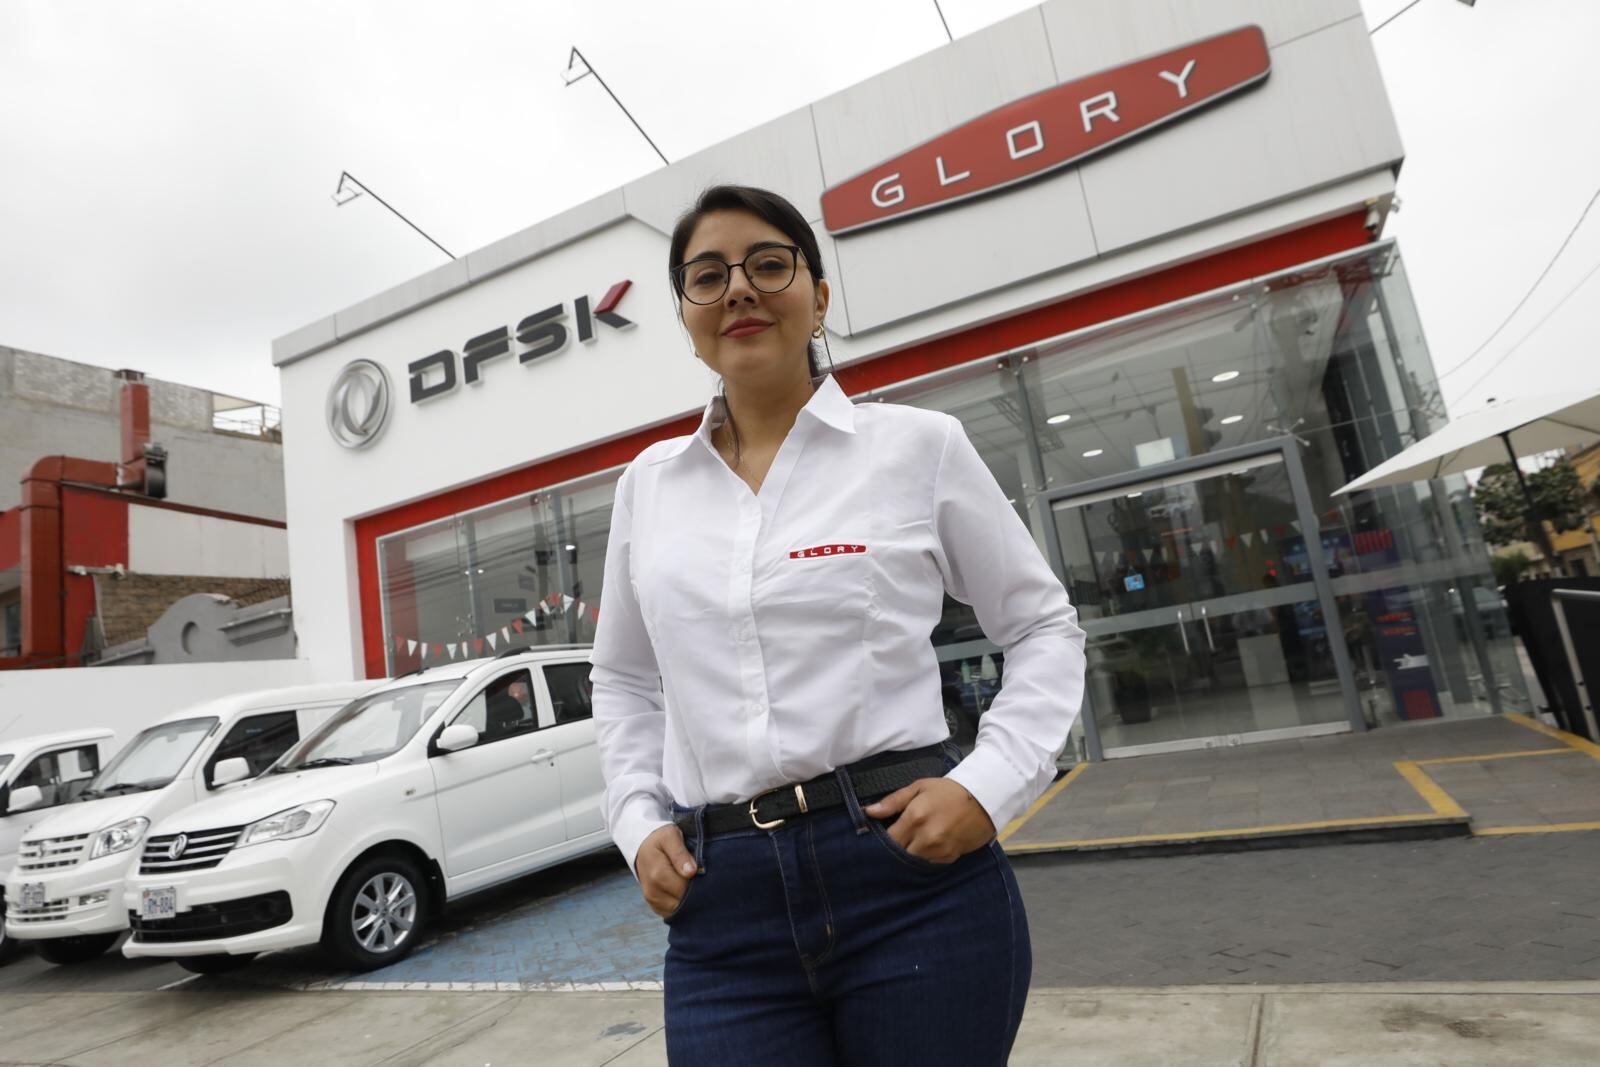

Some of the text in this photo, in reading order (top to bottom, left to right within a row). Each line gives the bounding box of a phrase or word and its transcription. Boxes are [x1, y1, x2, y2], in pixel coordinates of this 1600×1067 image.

[871, 59, 1196, 208] GLORY
[408, 279, 635, 405] DFSK
[797, 545, 858, 558] GLORY
